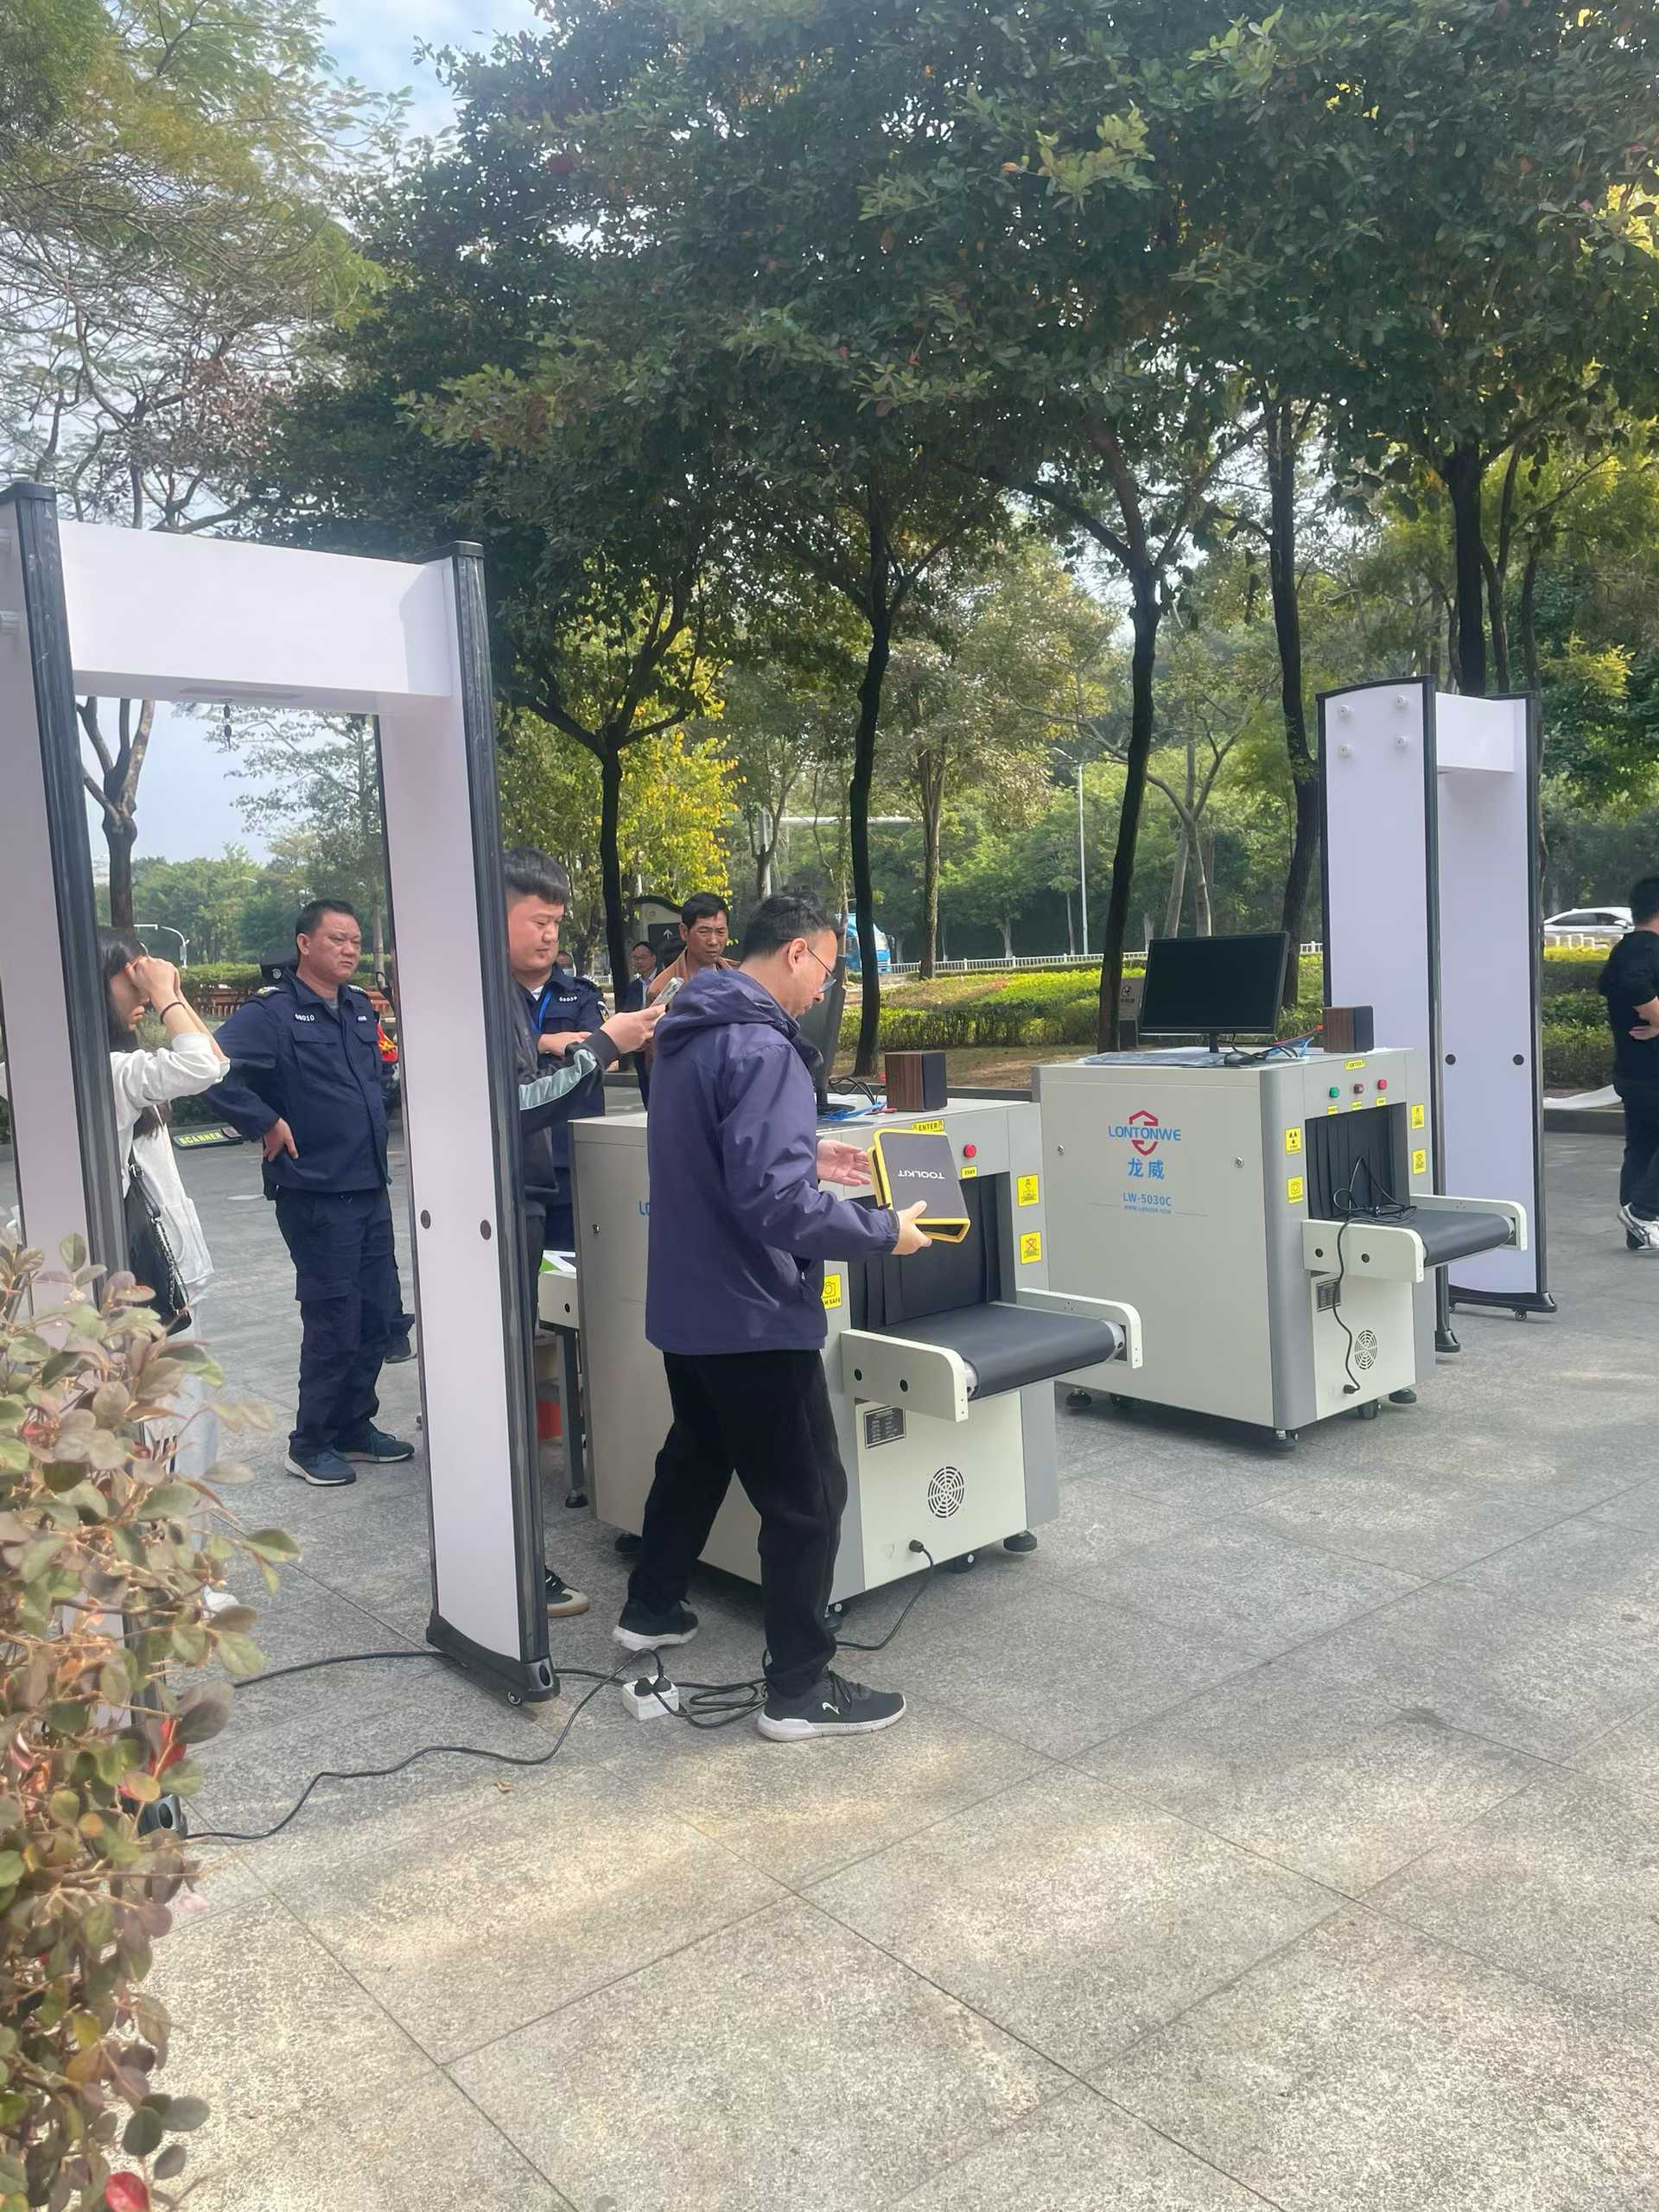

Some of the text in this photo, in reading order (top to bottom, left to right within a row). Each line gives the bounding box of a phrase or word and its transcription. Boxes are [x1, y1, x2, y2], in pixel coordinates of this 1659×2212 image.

[918, 1122, 939, 1131] ENTER
[1108, 1125, 1182, 1141] LONTONWE
[179, 1132, 223, 1145] SCANNER
[898, 1169, 945, 1179] TOOLKIT
[1128, 1157, 1165, 1179] 龙威
[1122, 1192, 1173, 1206] LW-5030C
